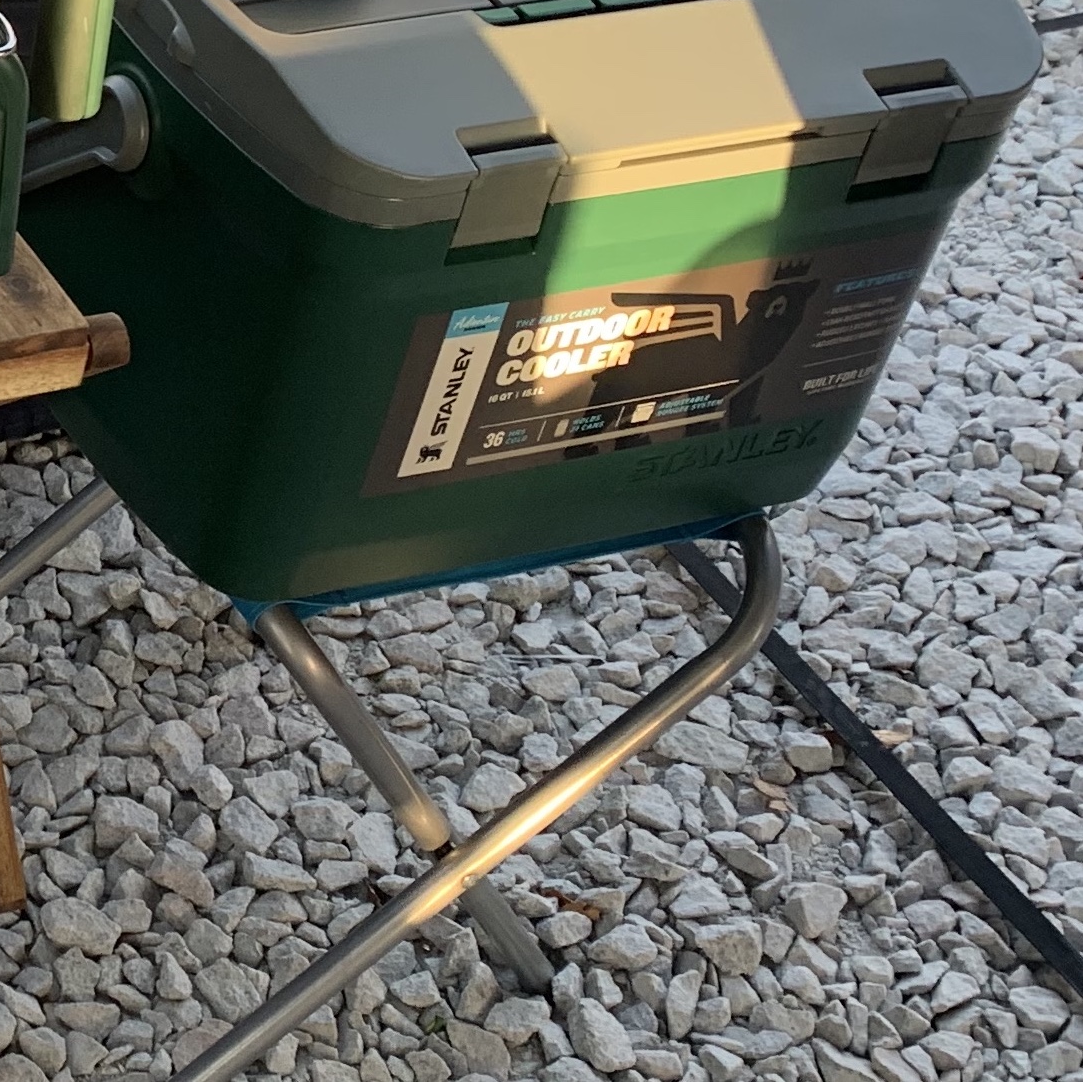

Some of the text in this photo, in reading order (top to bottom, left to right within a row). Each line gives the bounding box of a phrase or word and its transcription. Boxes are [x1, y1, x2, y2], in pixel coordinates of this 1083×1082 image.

[506, 305, 676, 357] OUTDOOR
[516, 306, 606, 328] THE EASY CARRY
[495, 340, 635, 387] COOLER
[430, 347, 474, 437] STANLEY
[499, 392, 513, 403] QT
[483, 430, 505, 449] 36
[629, 419, 824, 484] STANLEY
